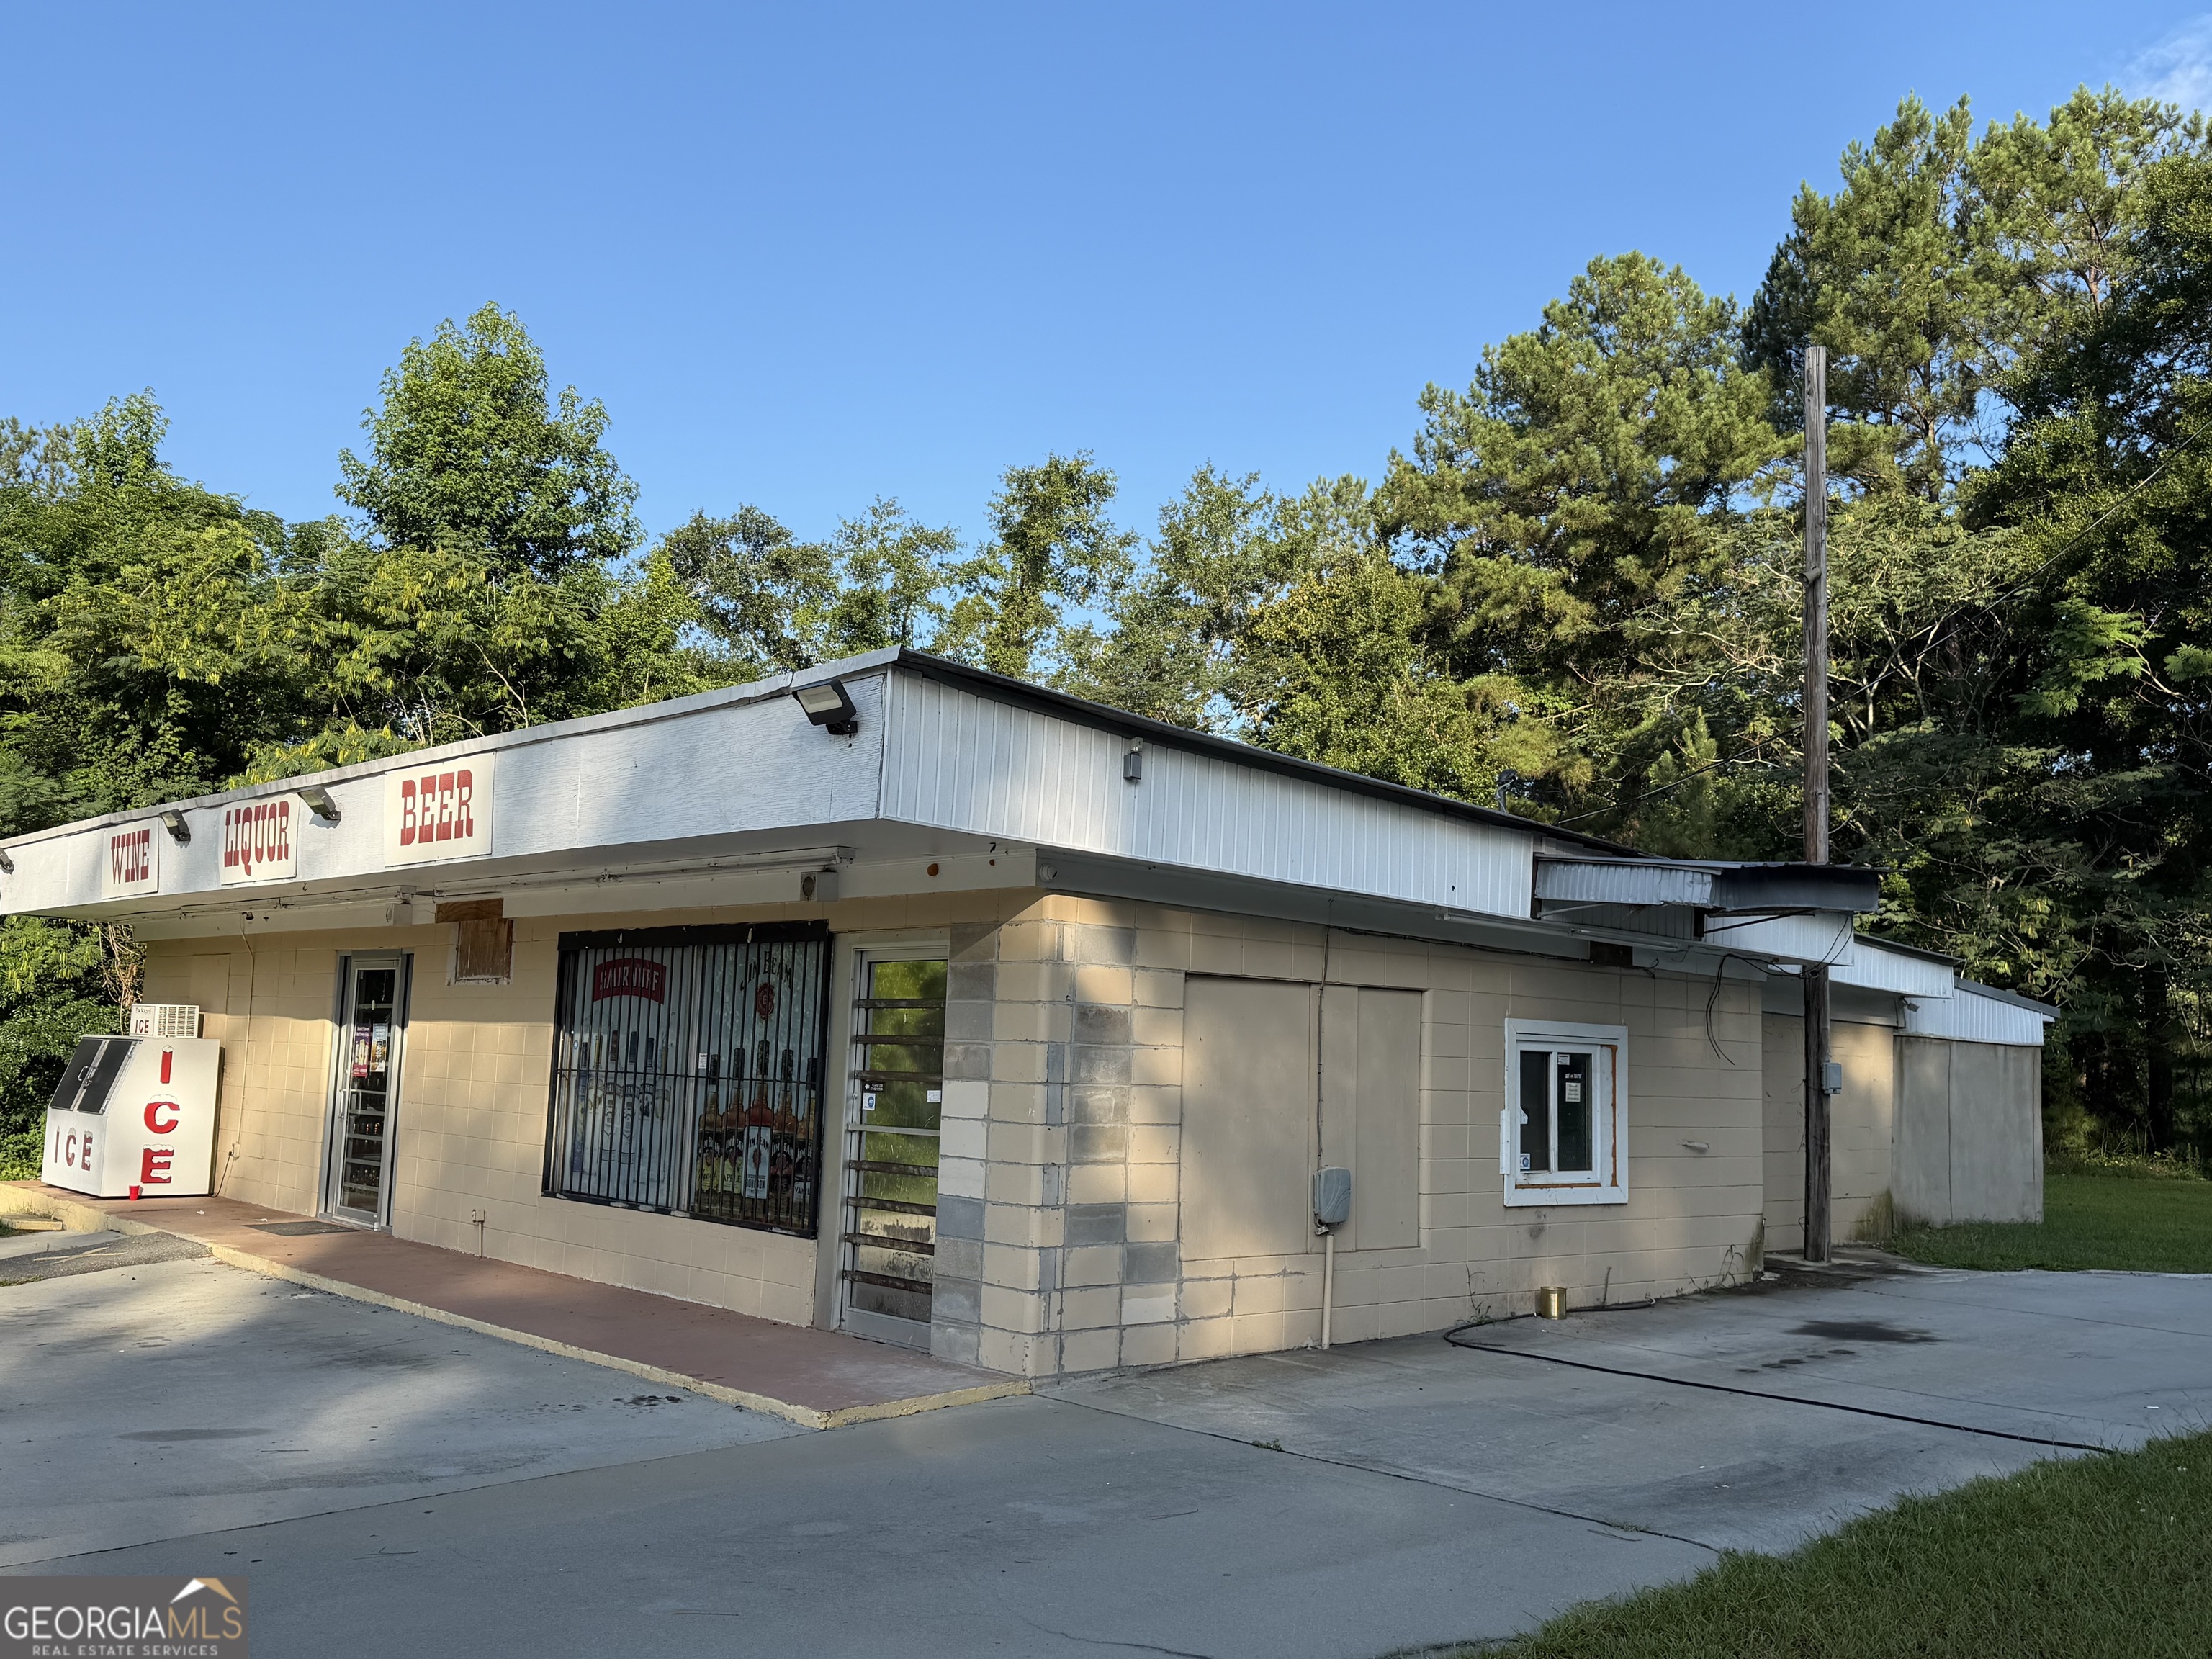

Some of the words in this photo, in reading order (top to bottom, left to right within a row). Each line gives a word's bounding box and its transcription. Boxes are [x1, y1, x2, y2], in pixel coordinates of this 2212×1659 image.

[224, 801, 289, 876] LIQUOR
[400, 770, 473, 846] BEER
[111, 829, 150, 884] WINE
[135, 1019, 150, 1033] ICE
[141, 1045, 180, 1184] ICE
[54, 1125, 94, 1172] ICE
